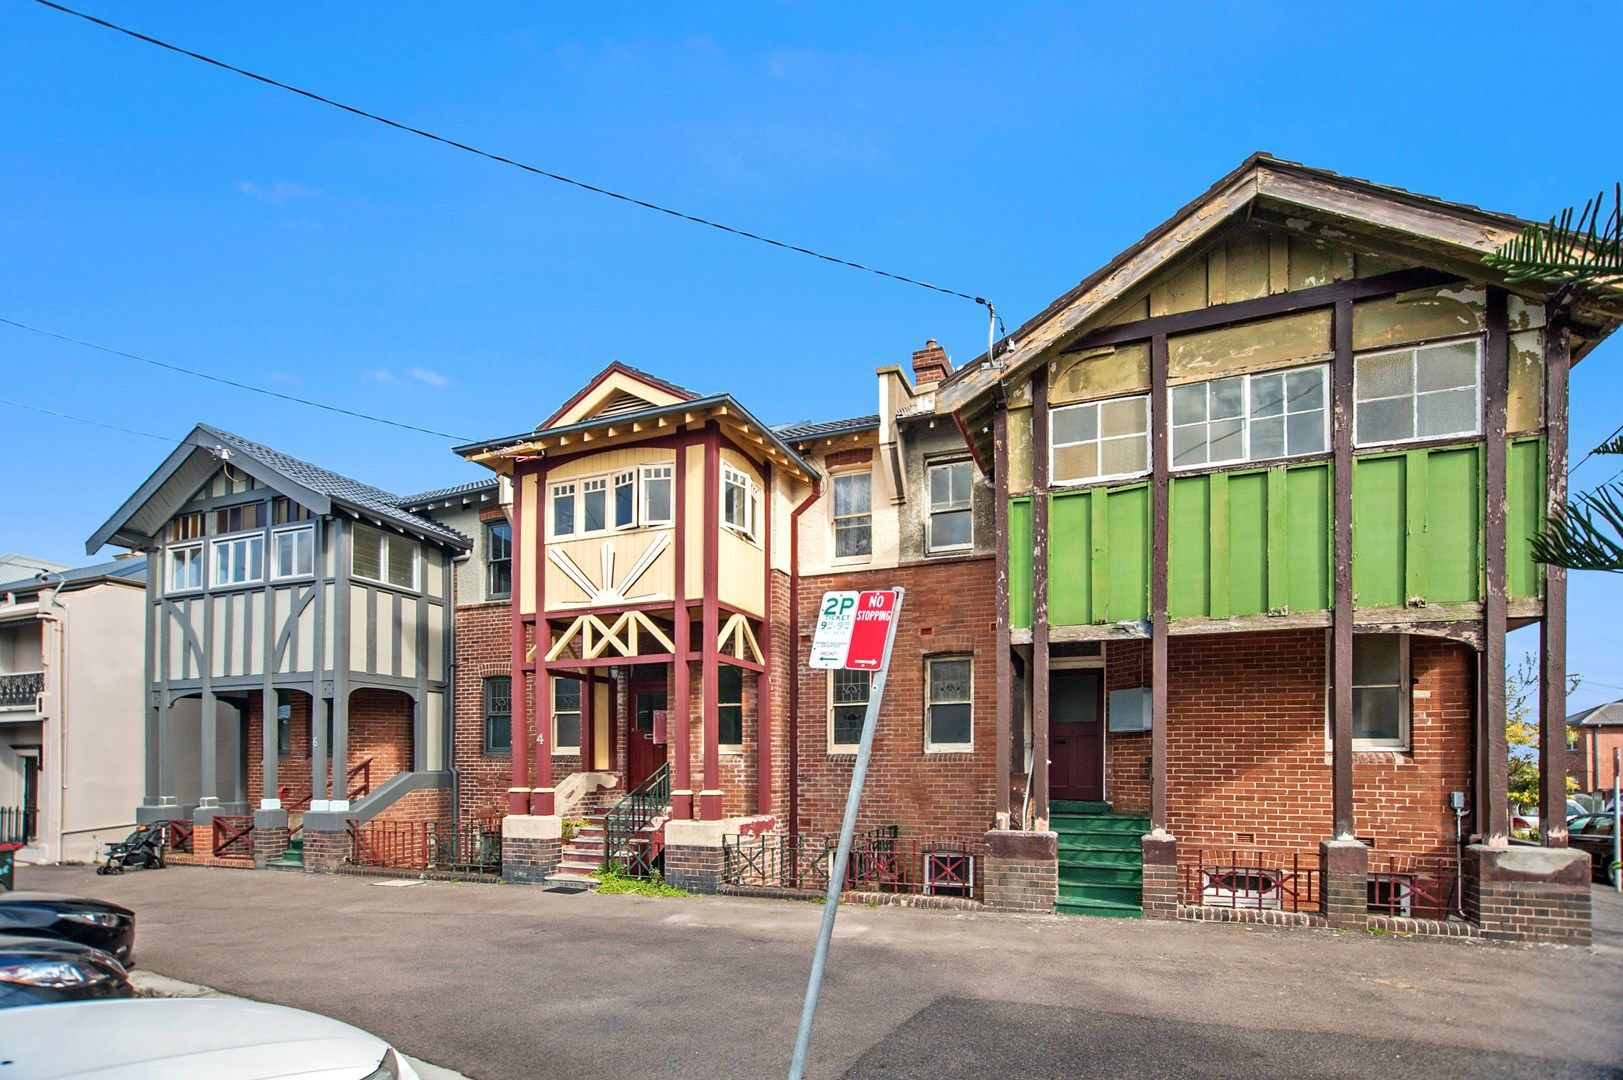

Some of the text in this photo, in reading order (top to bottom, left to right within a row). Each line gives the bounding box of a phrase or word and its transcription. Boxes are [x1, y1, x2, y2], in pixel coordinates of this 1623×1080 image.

[824, 597, 855, 615] 2P
[868, 596, 885, 608] NO
[856, 610, 892, 621] STOPPING
[312, 736, 319, 747] 6
[536, 732, 544, 745] 4
